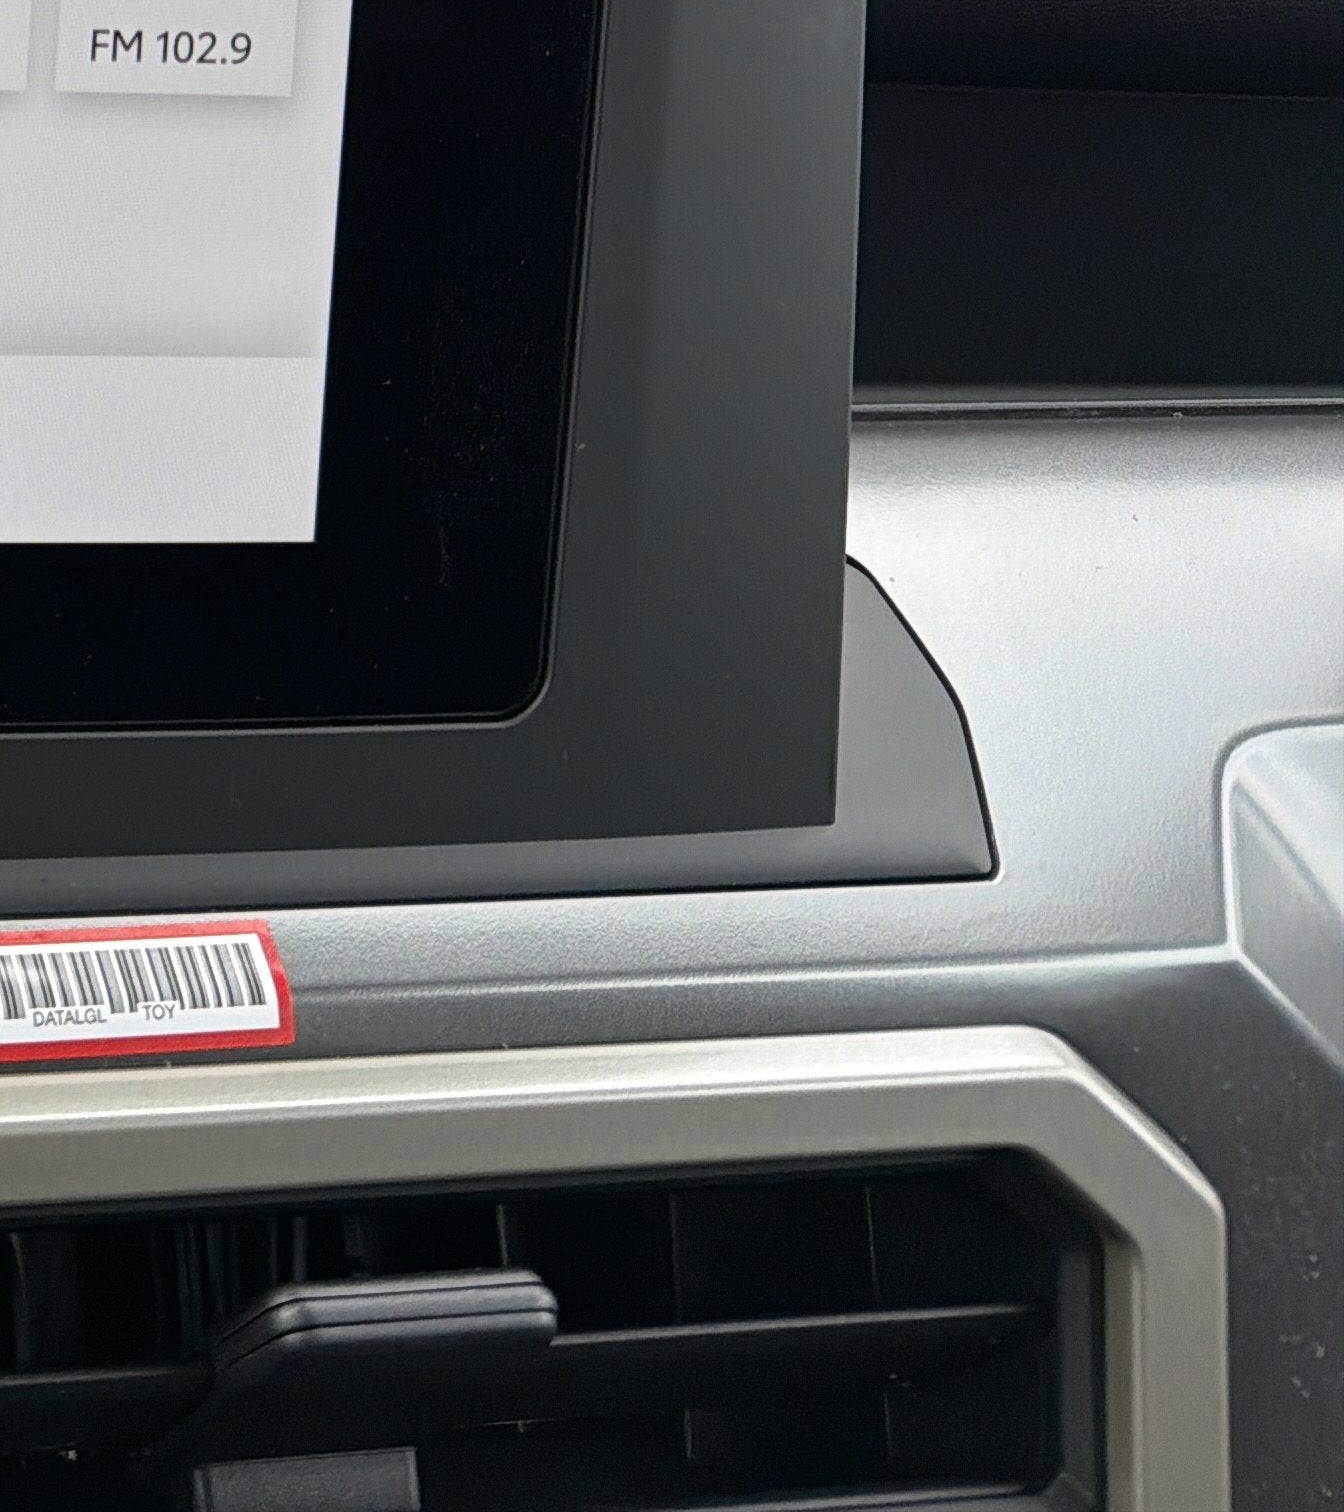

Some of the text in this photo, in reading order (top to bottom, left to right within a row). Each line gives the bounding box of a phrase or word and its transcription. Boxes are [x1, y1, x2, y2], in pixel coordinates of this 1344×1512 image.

[90, 29, 253, 65] FM 102.9
[31, 1007, 108, 1028] DATALGL
[141, 1003, 177, 1021] TOY
